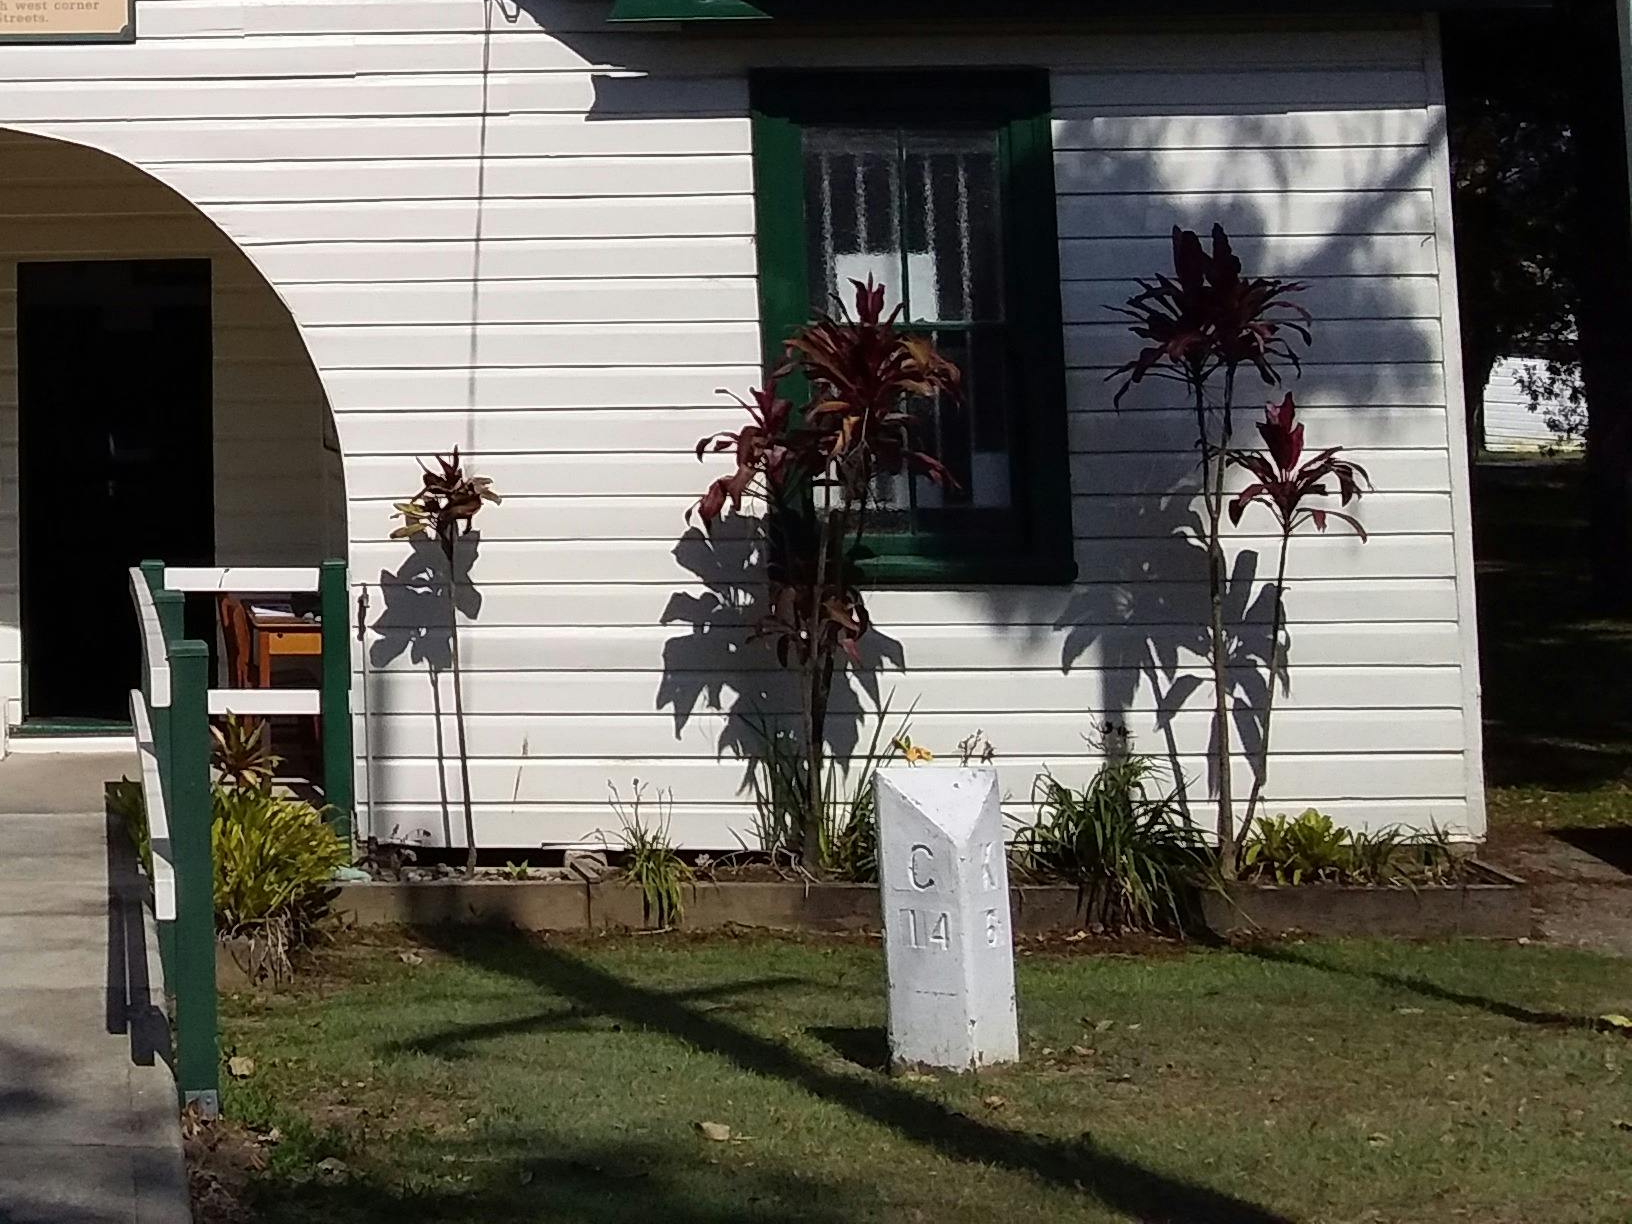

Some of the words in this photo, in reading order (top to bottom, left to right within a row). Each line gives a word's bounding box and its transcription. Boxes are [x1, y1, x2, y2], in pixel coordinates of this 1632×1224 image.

[16, 1, 46, 10] west
[54, 1, 100, 10] corner
[908, 843, 935, 892] C
